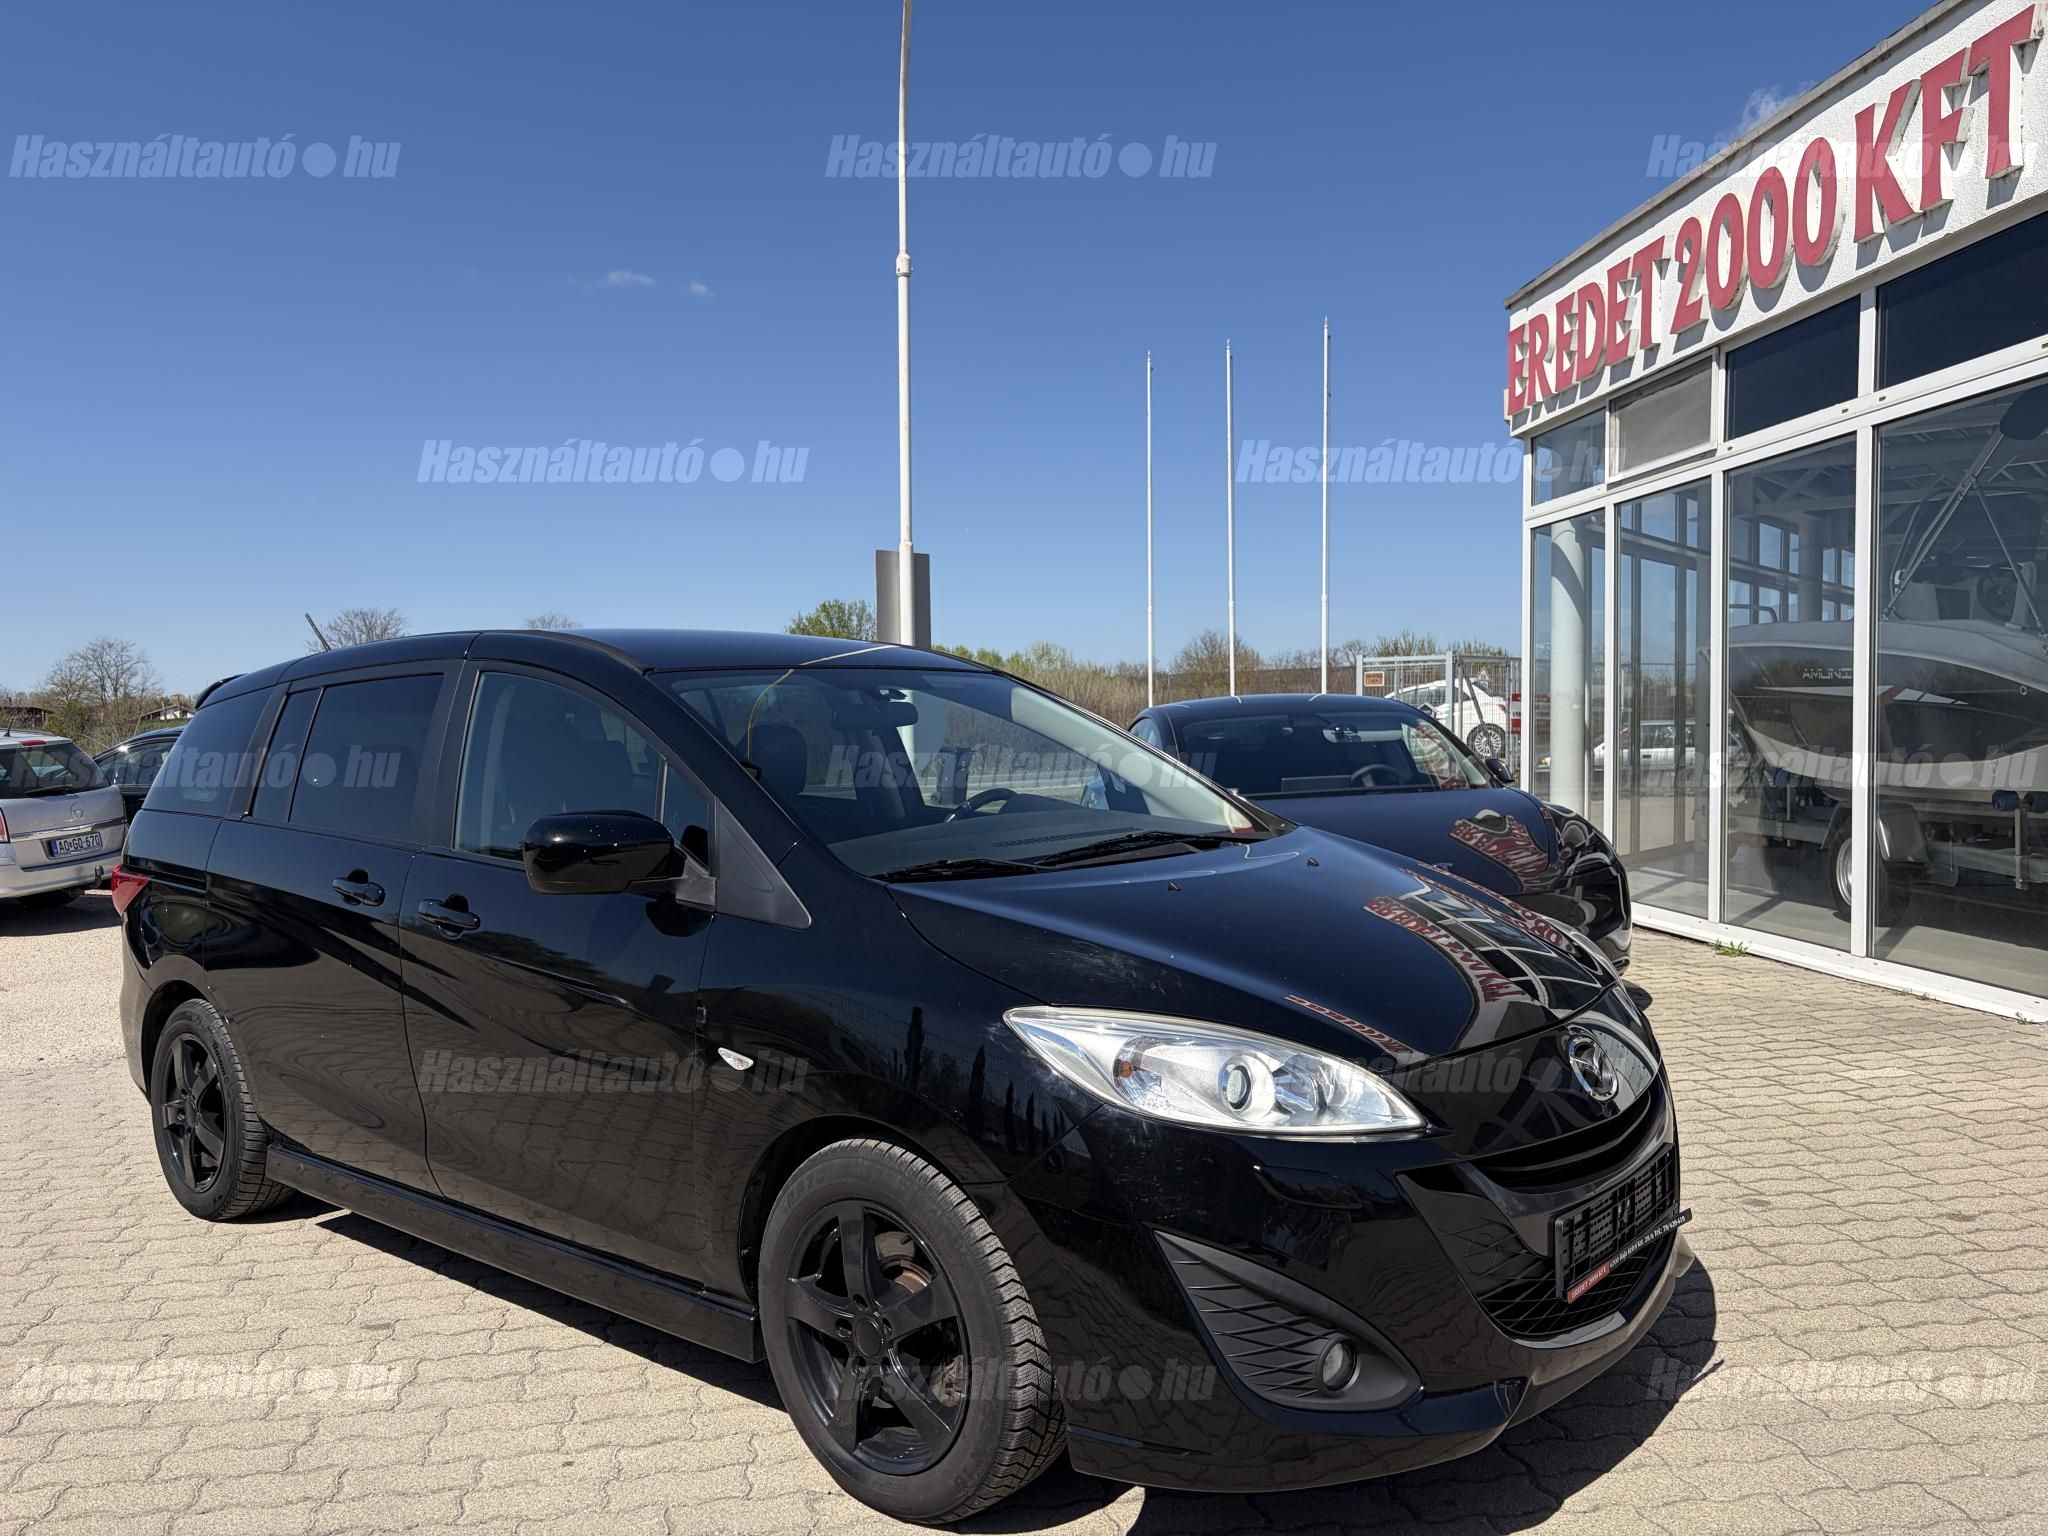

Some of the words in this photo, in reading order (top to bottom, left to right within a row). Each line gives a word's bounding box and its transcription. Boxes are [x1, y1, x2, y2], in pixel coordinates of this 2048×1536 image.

[1507, 235, 1669, 416] EREDET
[1670, 136, 1842, 335] 2000
[1853, 3, 2040, 243] KFT
